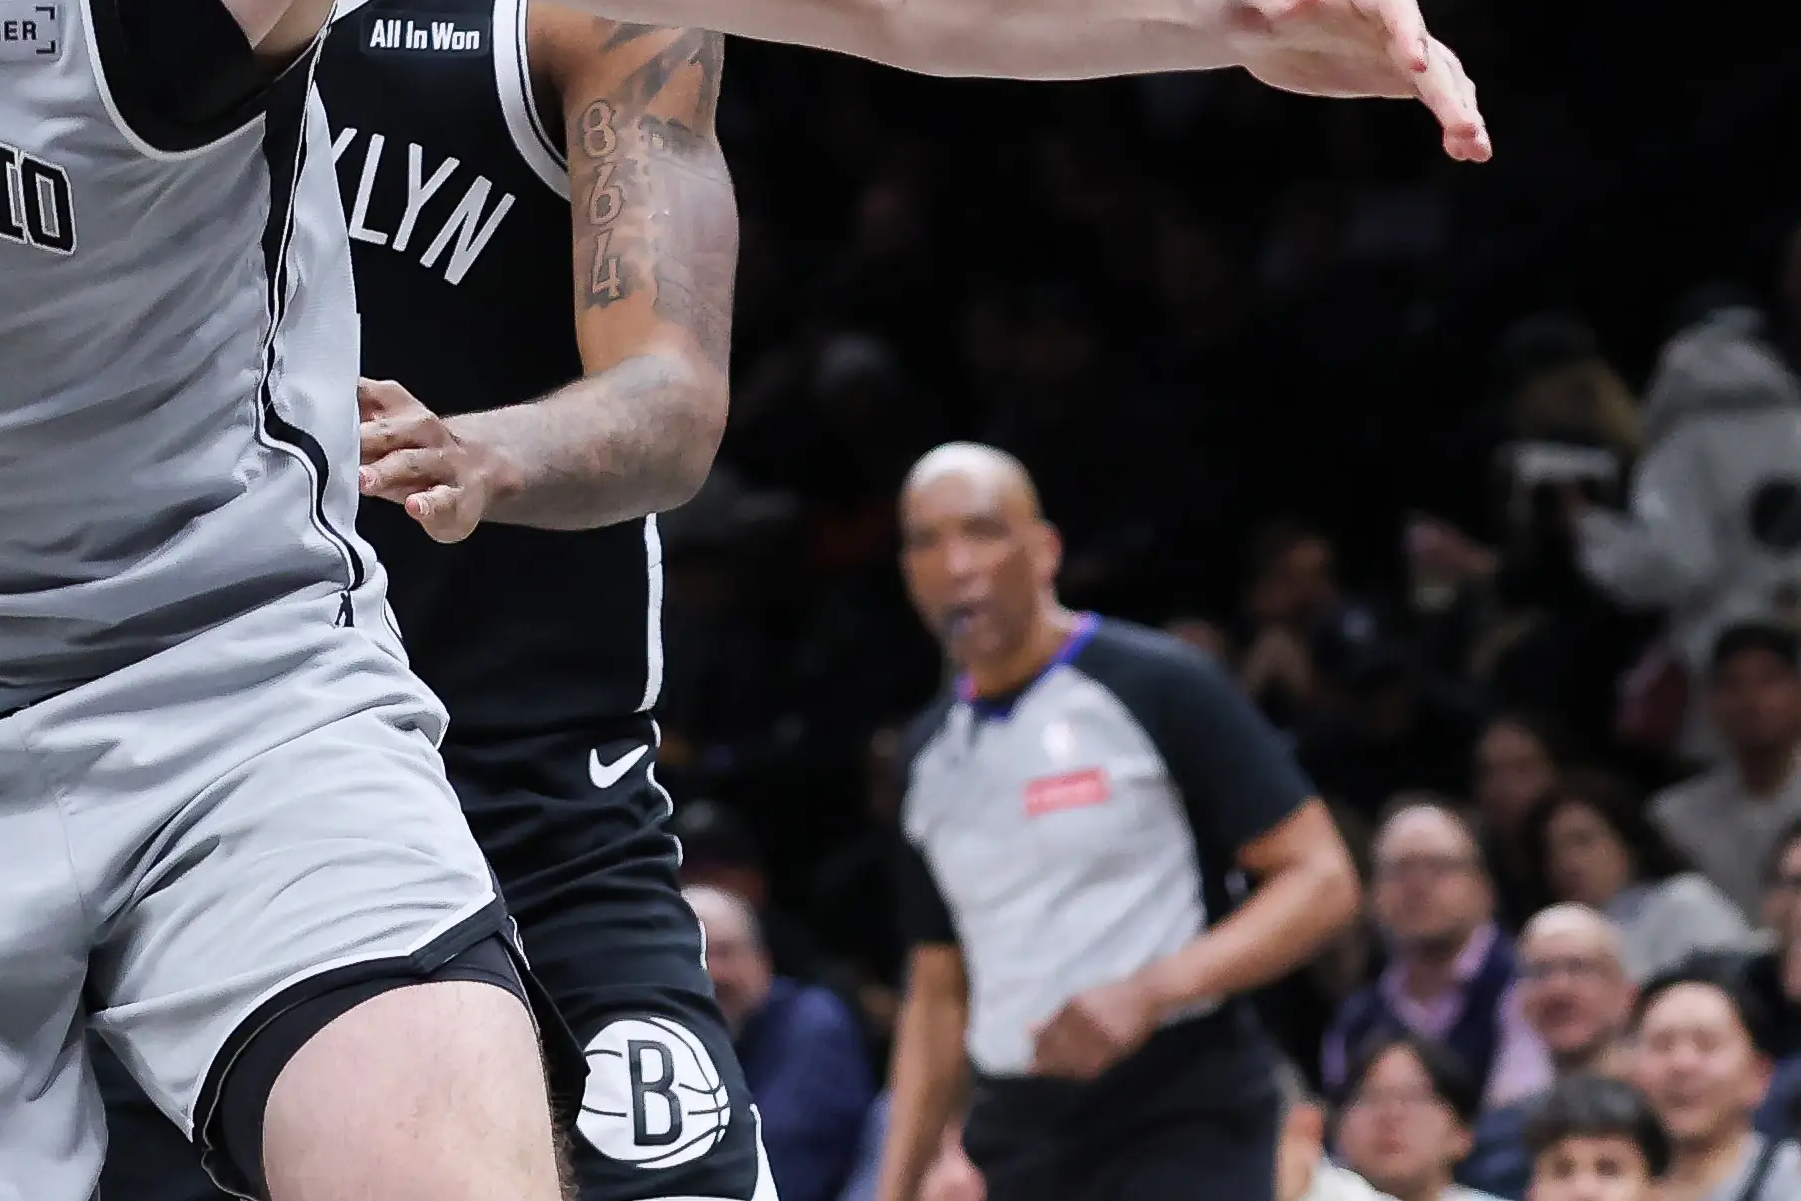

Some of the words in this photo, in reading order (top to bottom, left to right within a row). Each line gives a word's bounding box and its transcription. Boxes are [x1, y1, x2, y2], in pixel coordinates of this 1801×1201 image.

[369, 18, 402, 49] All
[405, 20, 428, 50] In
[431, 21, 480, 51] Won
[331, 127, 516, 286] LYN
[627, 1039, 683, 1146] B
